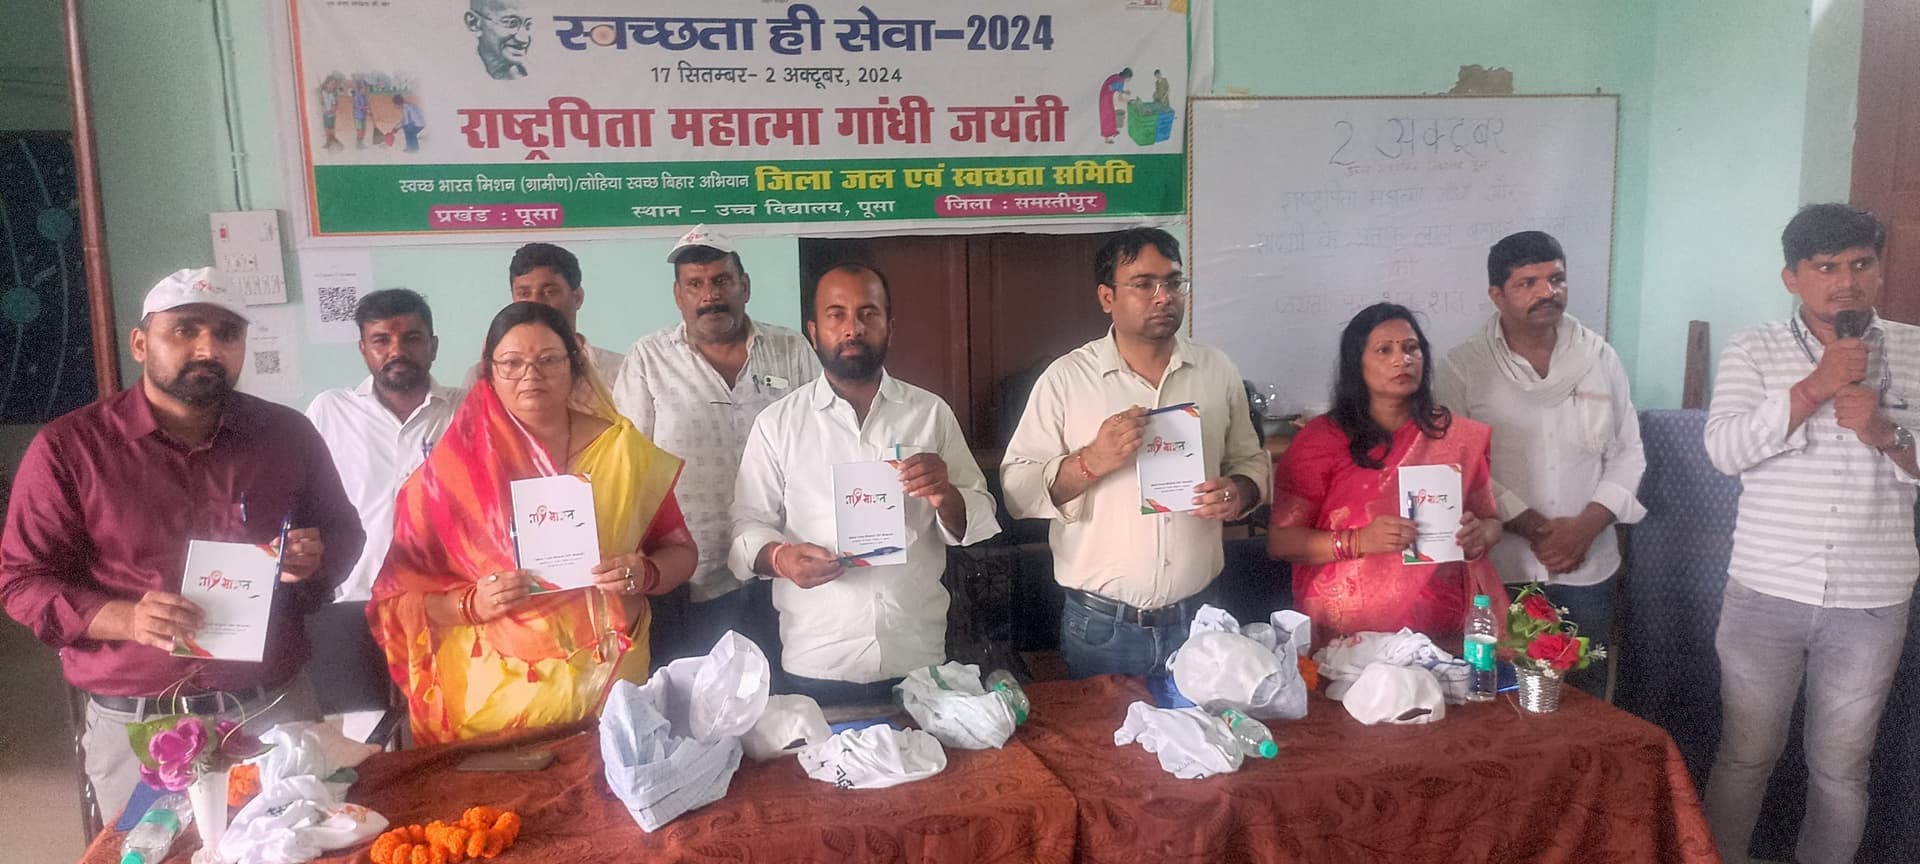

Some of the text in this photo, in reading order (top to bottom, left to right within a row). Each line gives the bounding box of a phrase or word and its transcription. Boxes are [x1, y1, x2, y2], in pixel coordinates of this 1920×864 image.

[553, 16, 757, 50] स्वच्छता
[766, 4, 825, 55] ही
[651, 67, 670, 83] 17
[766, 67, 776, 83] 2
[784, 67, 850, 90] अक्टूबर,
[859, 67, 903, 83] 2024
[457, 95, 1069, 160] राष्ट्रपिता महात्मा गांधी जयंती
[1329, 120, 1355, 165] 2
[399, 179, 434, 193] स्वच्छ
[439, 179, 473, 193] भारत
[477, 174, 516, 193] मिशन
[626, 177, 658, 190] स्वच्छ
[661, 171, 695, 190] बिहार
[699, 171, 750, 189] अभियान
[755, 166, 832, 191] जिला
[841, 170, 893, 189] जल
[903, 163, 945, 188] एवं
[951, 167, 1045, 187] स्वच्छता
[1052, 160, 1134, 184] समिति
[435, 207, 489, 223] प्रखंड
[515, 208, 558, 226] पूसा
[632, 205, 682, 219] स्थान
[714, 203, 757, 217] उच्च
[857, 201, 895, 218] पूसा
[945, 196, 992, 210] जिला
[1014, 193, 1098, 213] समस्तीपुर
